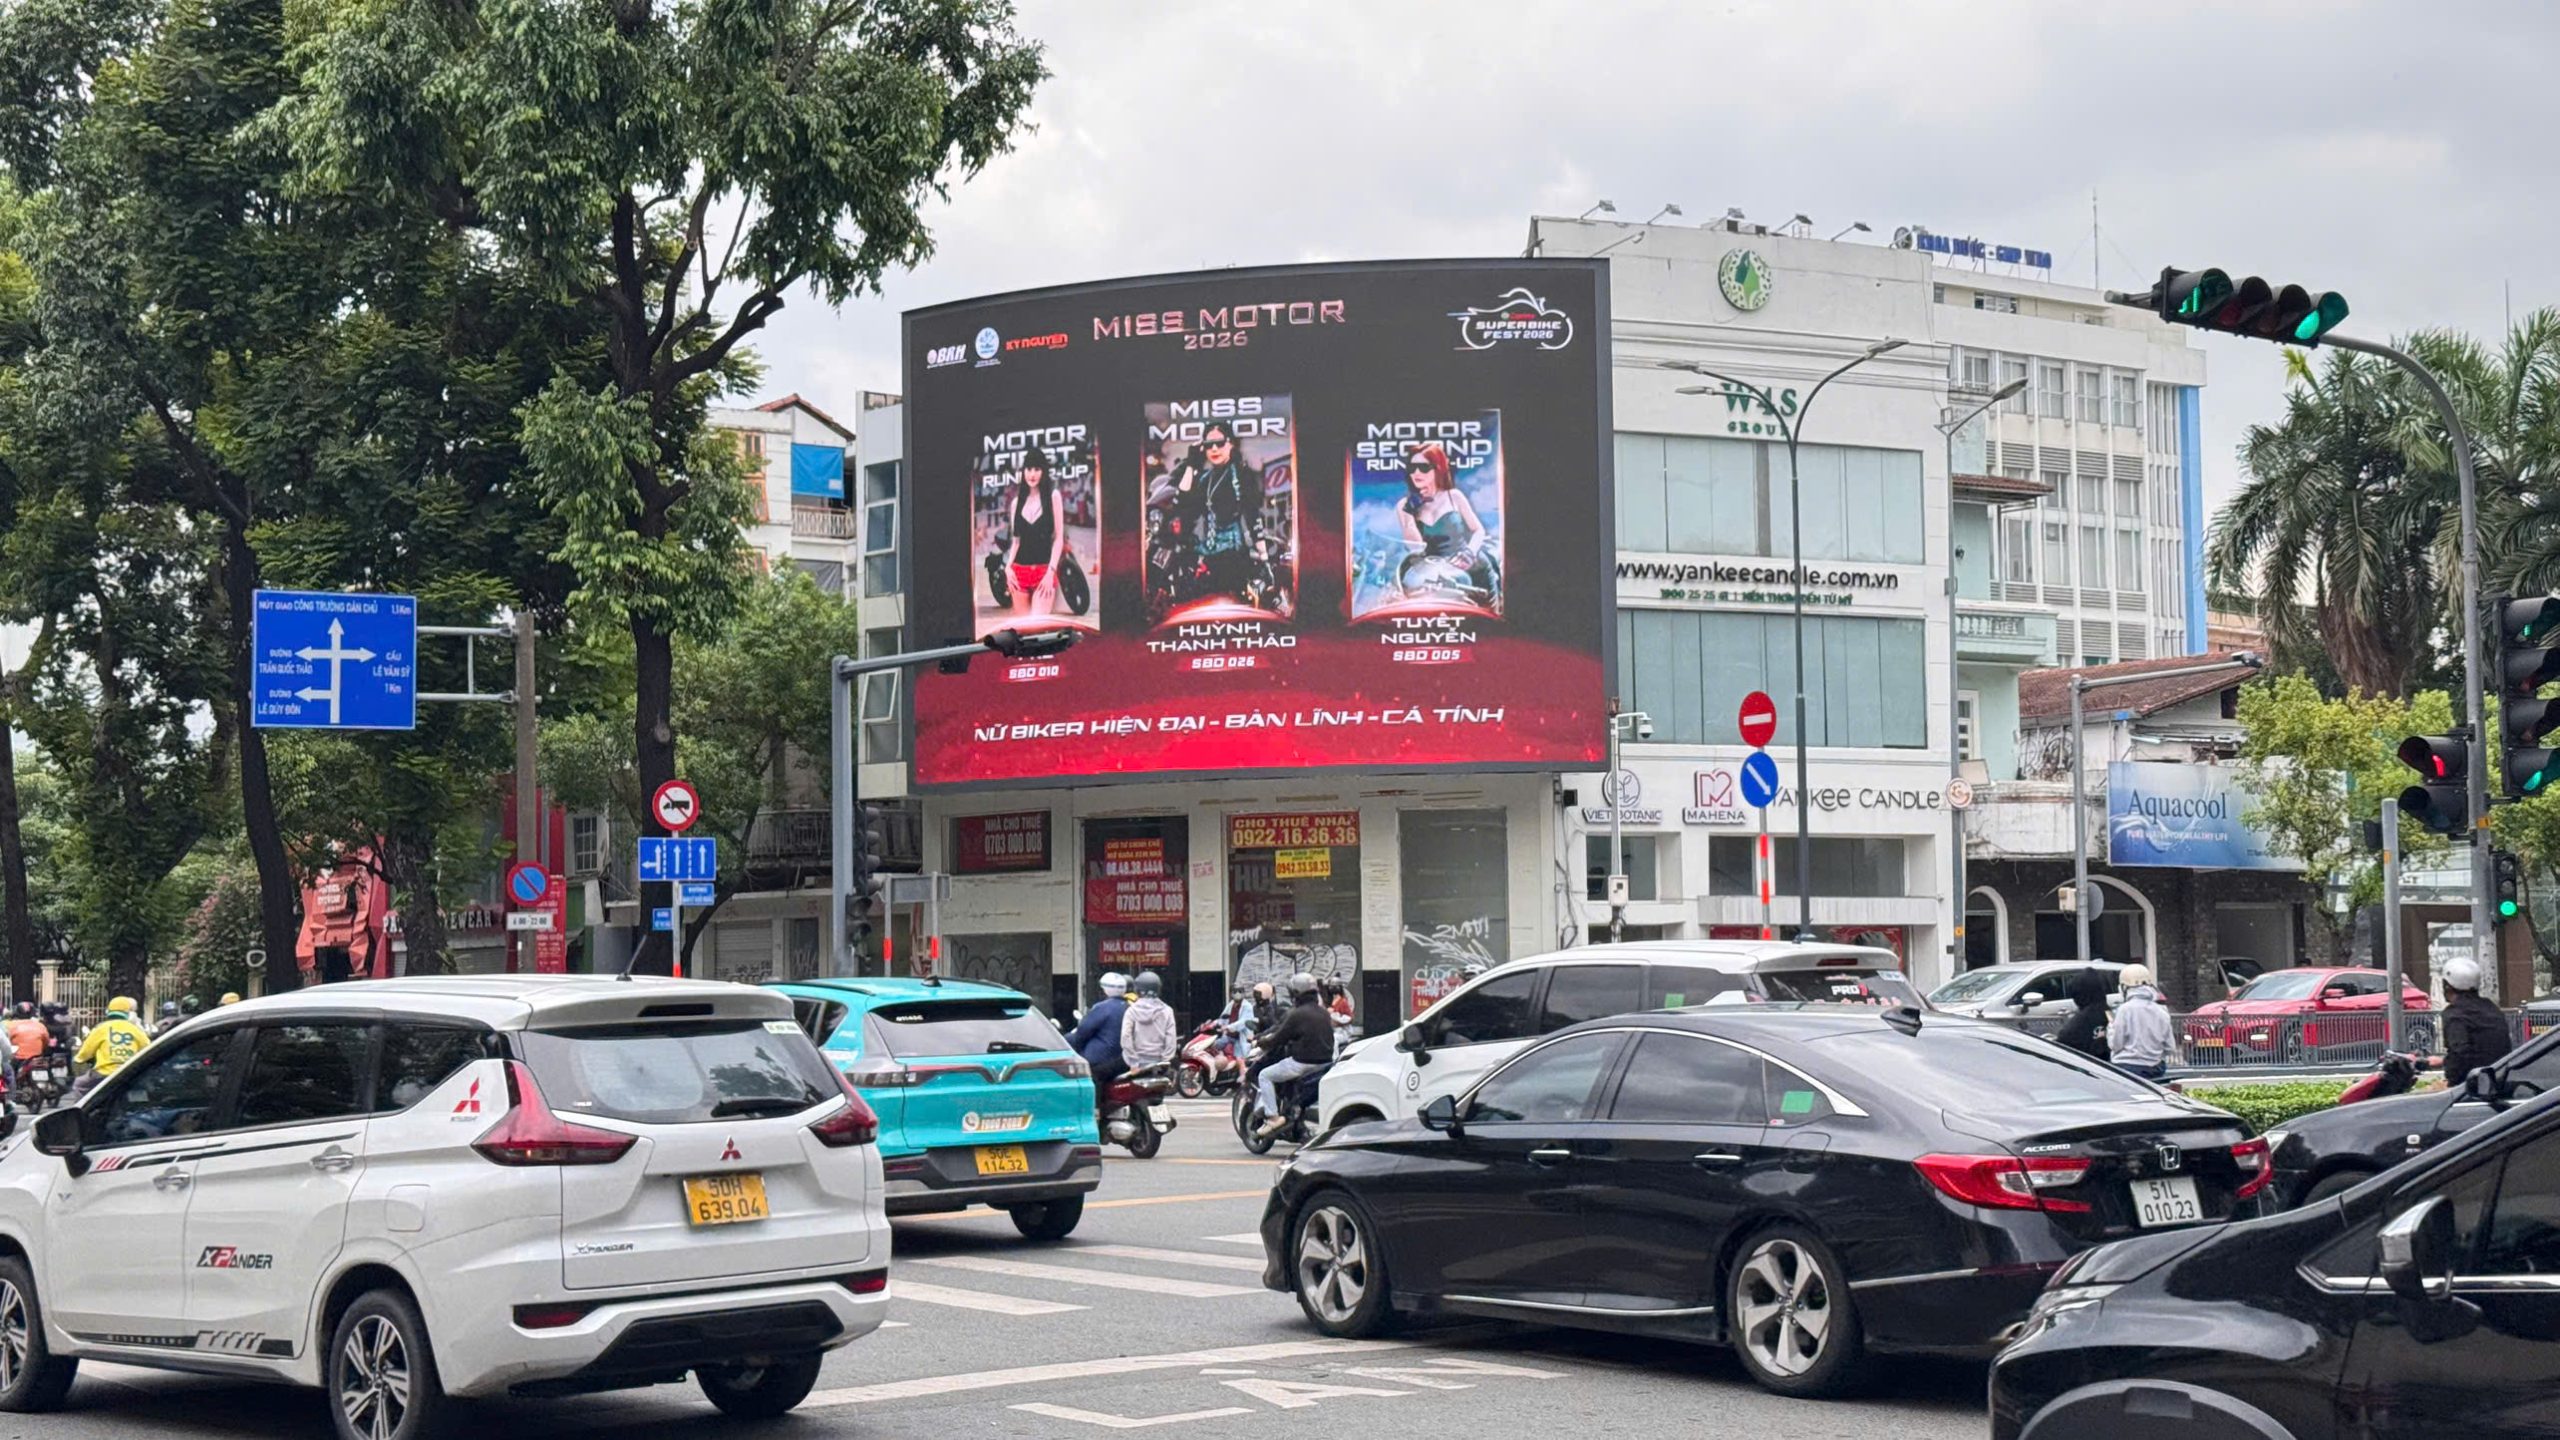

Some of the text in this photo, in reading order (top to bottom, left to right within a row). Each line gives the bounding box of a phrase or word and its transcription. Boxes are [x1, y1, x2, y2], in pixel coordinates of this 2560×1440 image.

[1093, 300, 1345, 340] MISS MOTOR
[1475, 321, 1561, 330] SUPERBIKE
[1184, 331, 1249, 350] 2026
[1483, 330, 1554, 339] FEST 2026
[1170, 396, 1262, 419] MISS
[1149, 417, 1286, 441] MOOR
[1367, 421, 1481, 439] MOTOR
[984, 424, 1086, 453] MOTOR
[1660, 588, 1685, 599] 1900
[1688, 589, 1701, 599] 25
[1703, 590, 1715, 600] 25
[1179, 621, 1261, 637] HUỲNH
[1381, 627, 1476, 644] NGUYỄN
[1147, 639, 1226, 653] THANH
[1192, 656, 1255, 669] SBD 026
[1393, 650, 1460, 661] SBD 005
[1008, 665, 1060, 679] SBD 010
[1011, 721, 1084, 739] BIKER
[1091, 715, 1152, 736] HIỆN
[1158, 716, 1205, 734] ĐẠI
[1295, 708, 1364, 727] LĨNH
[1433, 705, 1504, 723] TÍNH
[1687, 810, 1746, 820] MAHENA
[2128, 788, 2227, 825] Aquacool
[985, 813, 1041, 832] NHÀ CHO THUÊ
[1235, 819, 1266, 828] CHO
[985, 834, 1006, 855] 0703
[1233, 827, 1358, 846] 0922.16.36.36
[1117, 879, 1183, 892] NHÀ CHO THUÊ
[1116, 894, 1141, 911] 0703
[1103, 938, 1168, 952] NHÀ CHO THUÊ
[109, 1027, 134, 1045] be
[2023, 1143, 2071, 1153] ACCORD
[984, 1160, 1023, 1171] 114.32
[709, 1178, 743, 1198] 50H
[2151, 1181, 2179, 1200] 51L
[699, 1197, 761, 1221] 639.04
[2144, 1200, 2195, 1222] 010.23
[200, 1248, 273, 1269] XPANDER
